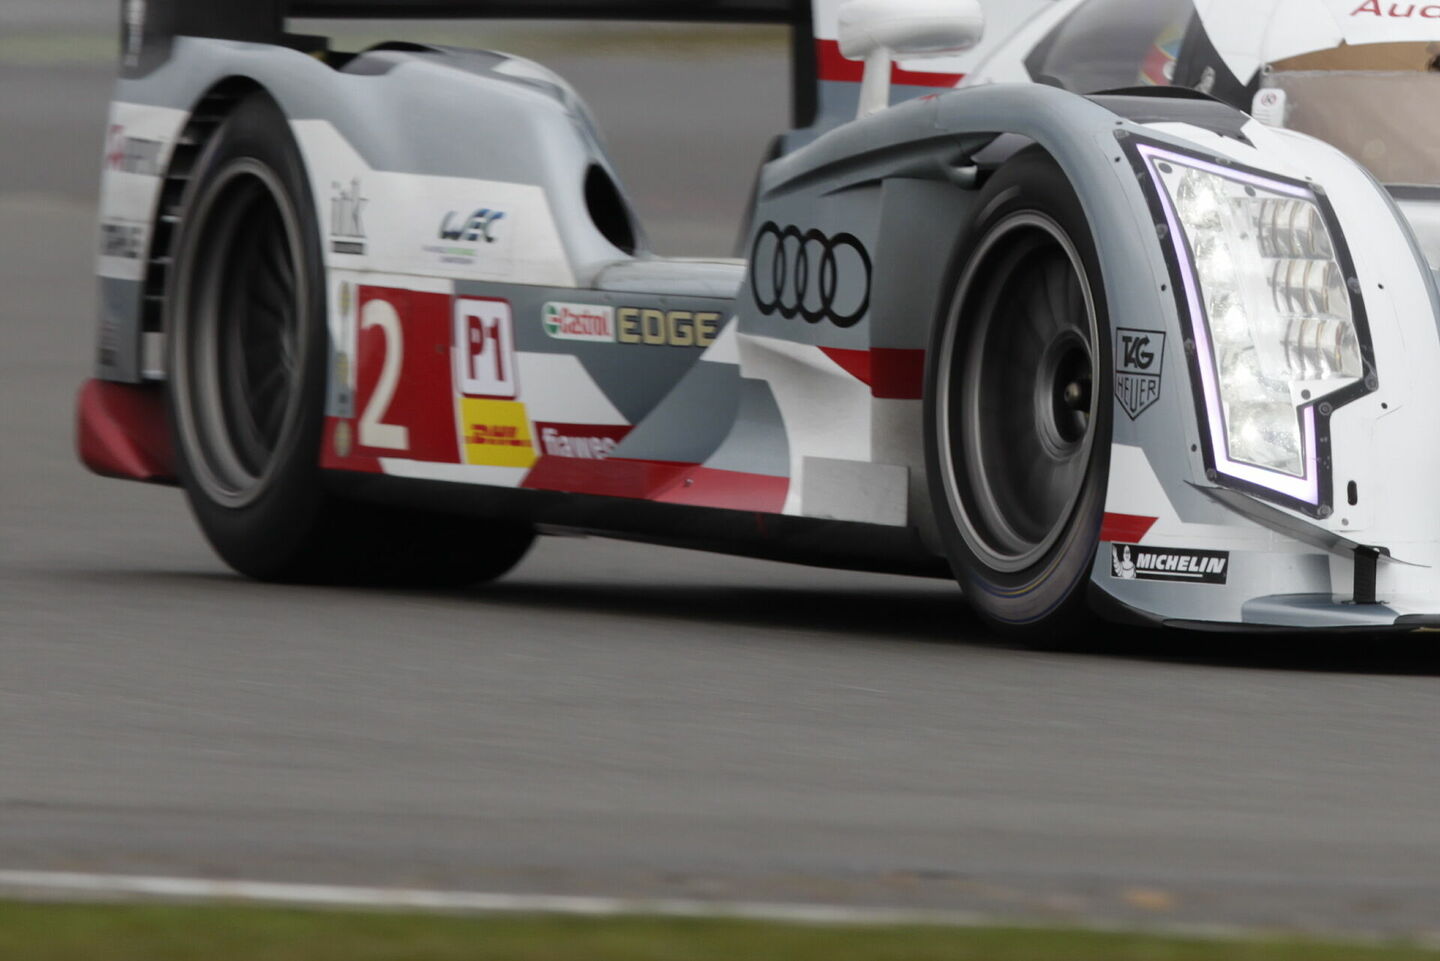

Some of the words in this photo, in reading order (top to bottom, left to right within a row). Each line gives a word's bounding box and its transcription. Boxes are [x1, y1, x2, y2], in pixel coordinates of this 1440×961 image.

[438, 208, 507, 244] WEC
[559, 307, 613, 337] Castrol
[616, 306, 721, 348] EDGE
[466, 314, 507, 382] P1
[1122, 334, 1155, 370] TAG
[359, 298, 411, 451] 2
[1117, 376, 1157, 413] HEUER
[1136, 552, 1226, 574] MICHELIN
